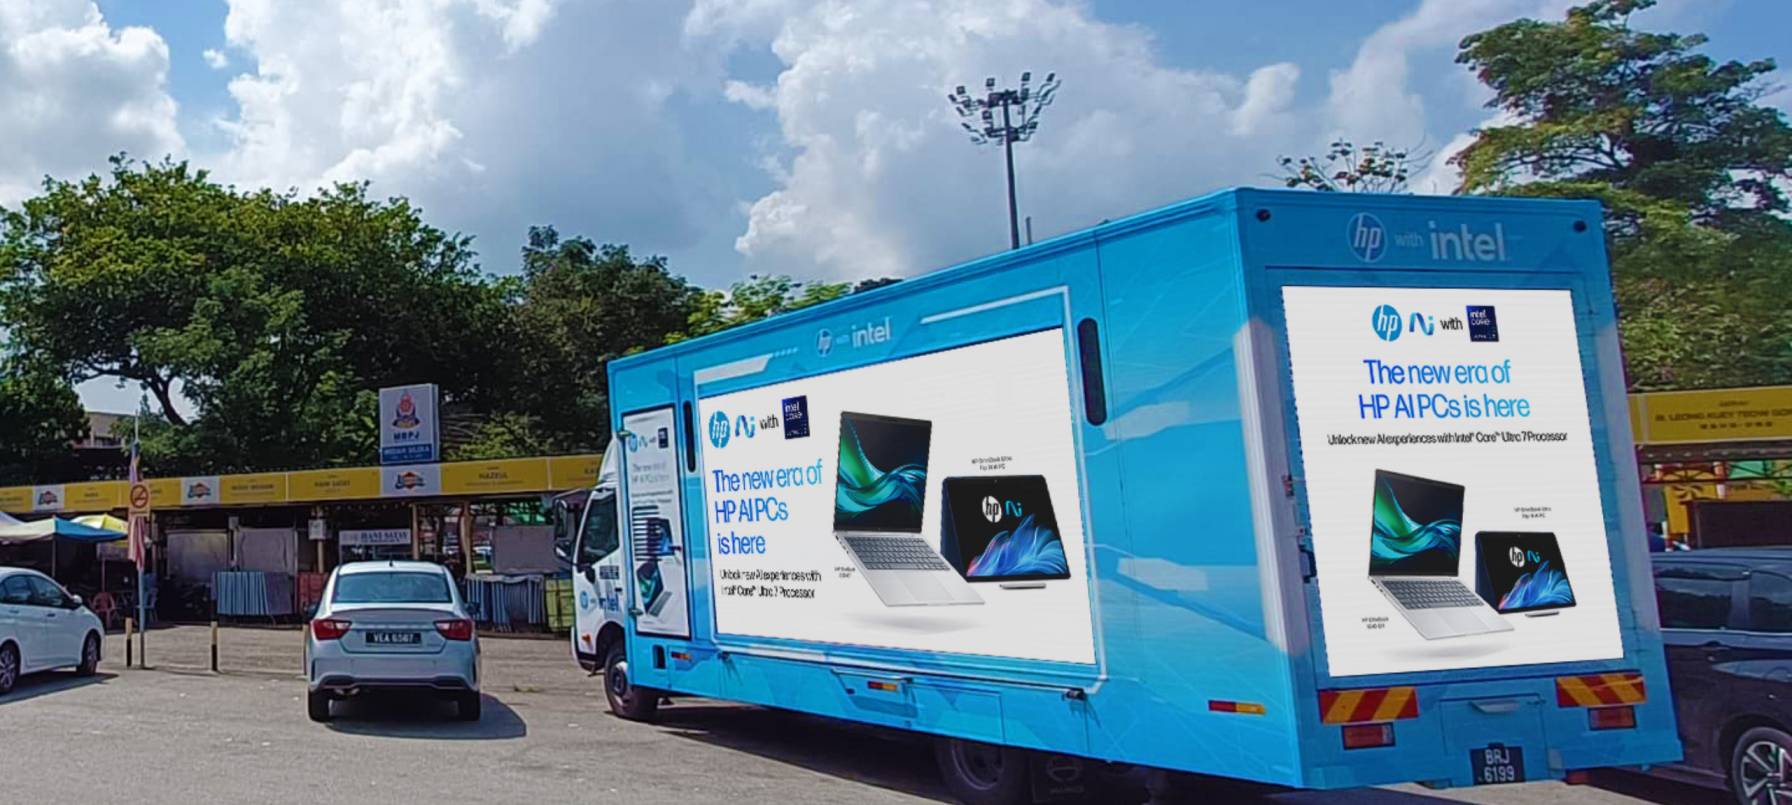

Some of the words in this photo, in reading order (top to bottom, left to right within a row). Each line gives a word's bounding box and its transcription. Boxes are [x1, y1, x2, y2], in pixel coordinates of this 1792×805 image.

[1351, 212, 1385, 263] hp
[1394, 231, 1424, 247] with
[1428, 220, 1506, 261] intel
[851, 316, 891, 349] intel
[1373, 304, 1401, 341] hp
[1440, 317, 1463, 331] with
[1363, 360, 1405, 384] The
[1408, 365, 1450, 384] new
[1454, 365, 1489, 384] era
[1491, 359, 1511, 384] of
[1358, 394, 1390, 419] HP
[1395, 394, 1415, 418] AI
[1417, 393, 1462, 418] PCs
[1464, 395, 1482, 418] is
[1483, 393, 1530, 417] here
[709, 411, 730, 448] hp
[760, 414, 779, 431] with
[712, 470, 740, 493] The
[742, 470, 773, 490] new
[776, 467, 803, 488] era
[806, 458, 823, 485] of
[715, 500, 736, 523] HP
[739, 499, 752, 522] AI
[755, 497, 788, 522] PCs
[984, 496, 1000, 523] hp
[717, 533, 729, 554] is
[731, 530, 766, 554] here
[1510, 546, 1523, 567] hp
[1484, 765, 1515, 782] 6199
